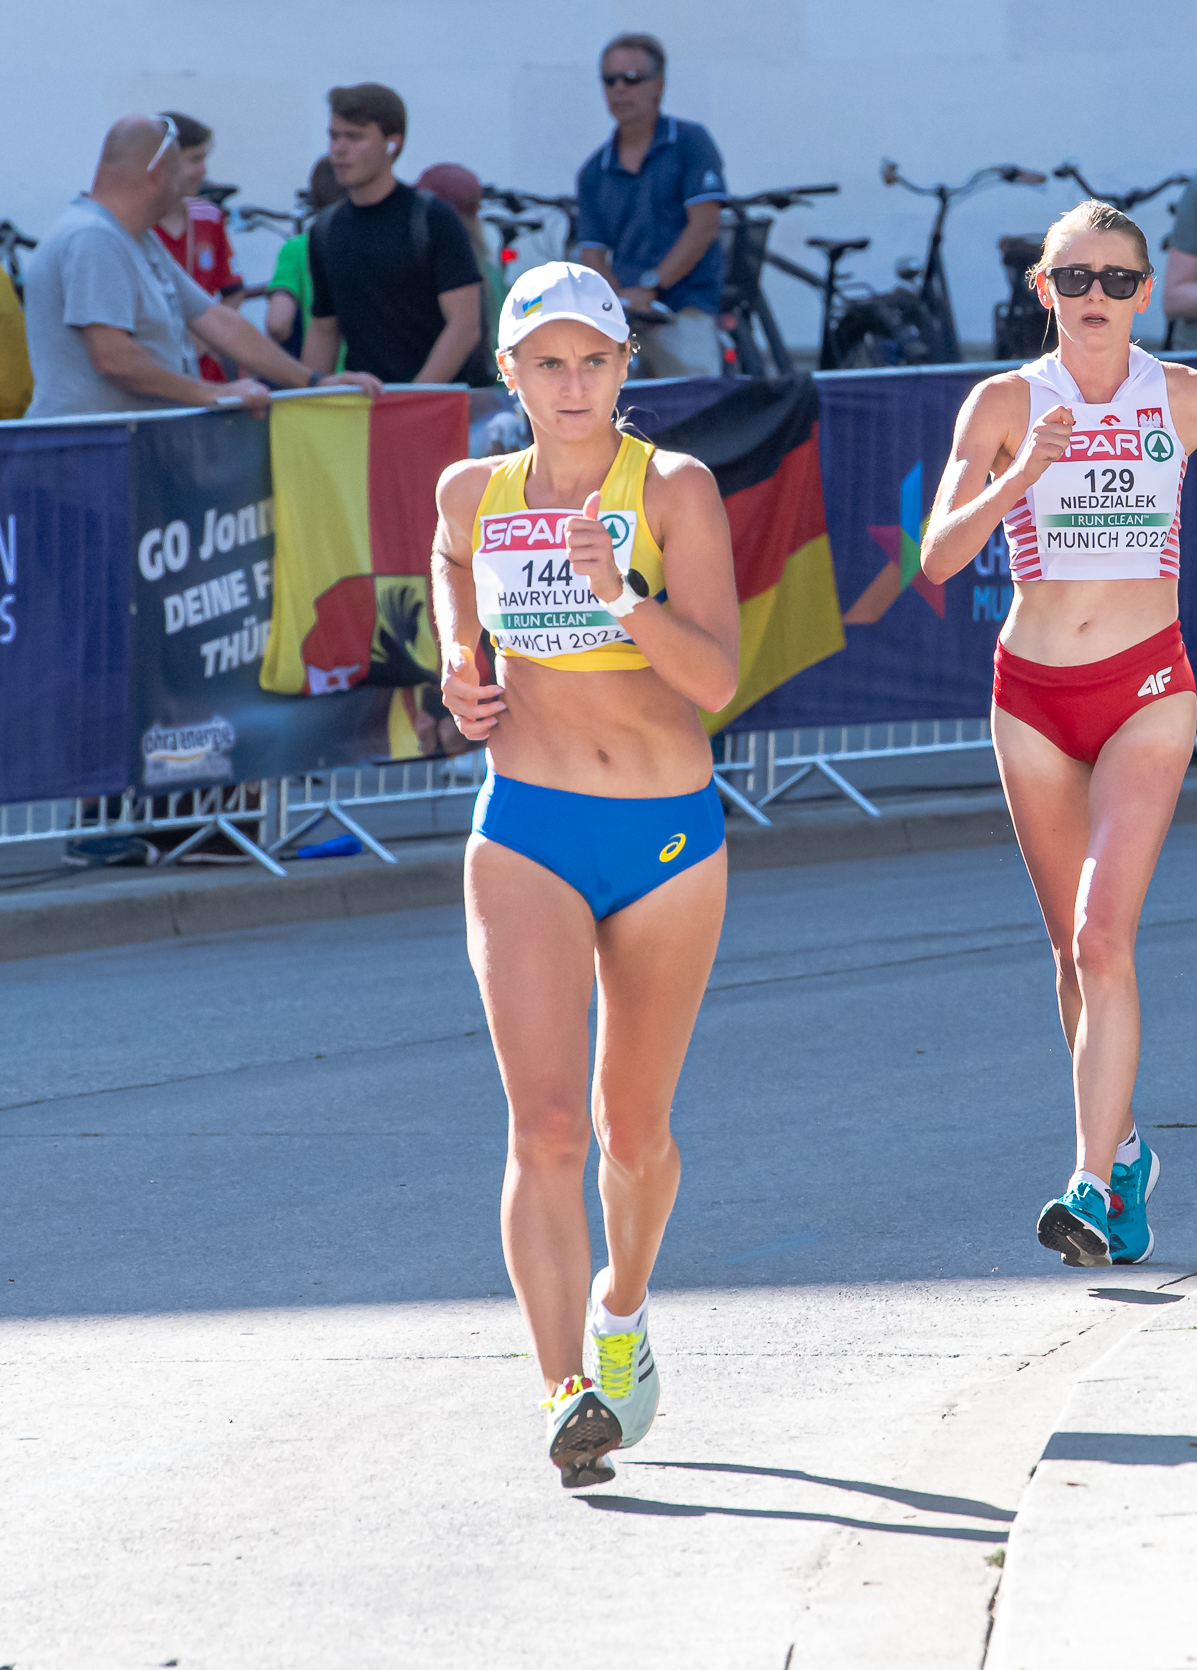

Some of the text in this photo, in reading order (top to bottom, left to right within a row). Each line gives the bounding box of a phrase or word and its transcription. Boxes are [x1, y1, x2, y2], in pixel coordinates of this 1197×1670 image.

[1064, 433, 1140, 458] PAR
[1084, 468, 1135, 493] 129
[1060, 495, 1157, 510] NIEDZIALEK
[1071, 515, 1075, 526] I
[1078, 515, 1105, 526] RUN
[137, 519, 190, 582] GO
[1047, 531, 1168, 549] MUNICH 2022
[521, 559, 573, 588] 144
[163, 568, 250, 636] DEINE
[497, 589, 600, 607] HAVRYLYUK
[507, 616, 512, 627] I
[514, 615, 541, 627] RUN
[200, 615, 271, 679] THÜ
[1137, 666, 1173, 698] 4F
